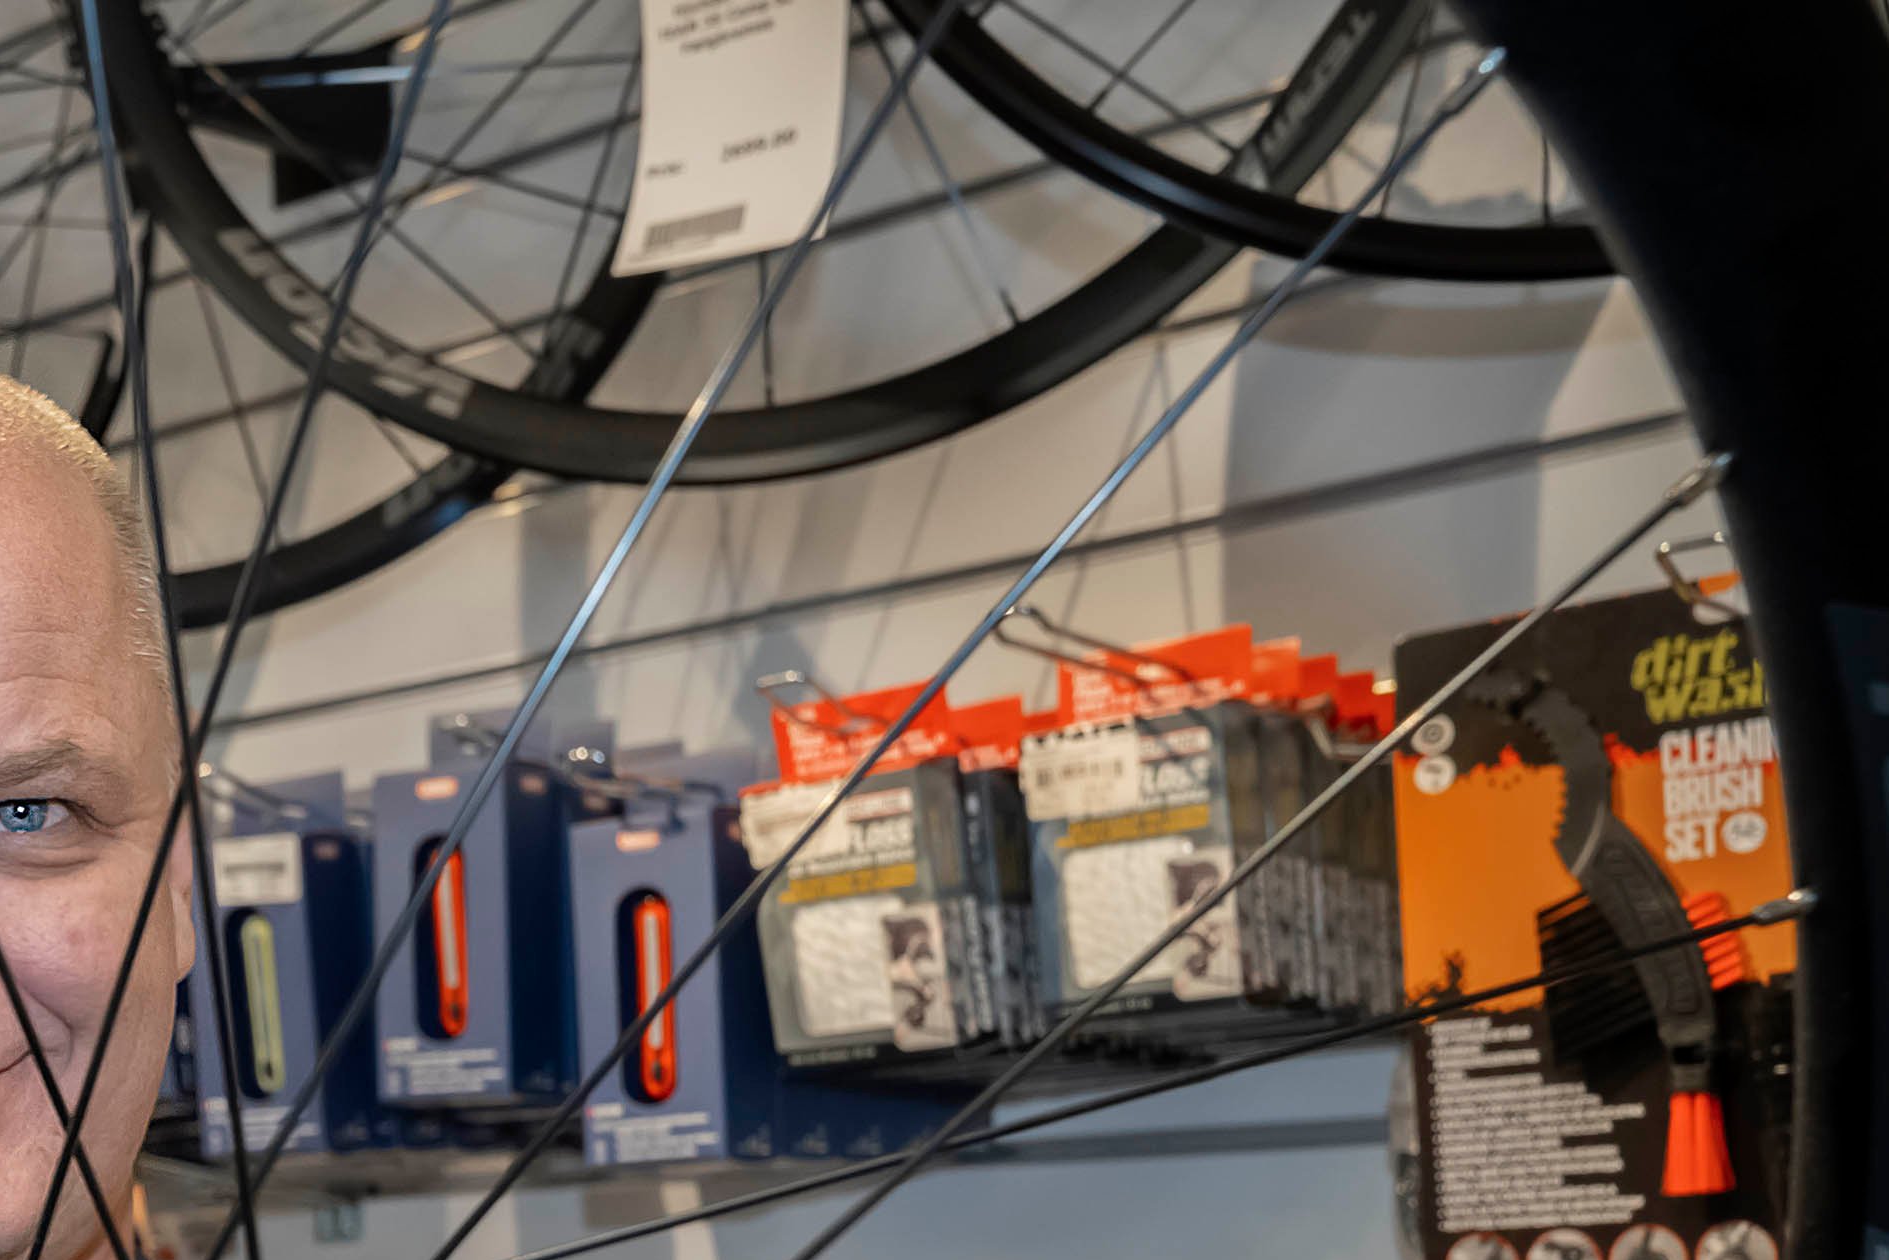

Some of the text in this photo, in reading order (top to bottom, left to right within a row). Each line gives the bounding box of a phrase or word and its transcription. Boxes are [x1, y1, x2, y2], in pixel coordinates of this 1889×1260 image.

[1630, 627, 1739, 691] dirt
[1664, 763, 1763, 822] BRUSH
[1665, 815, 1721, 863] SET
